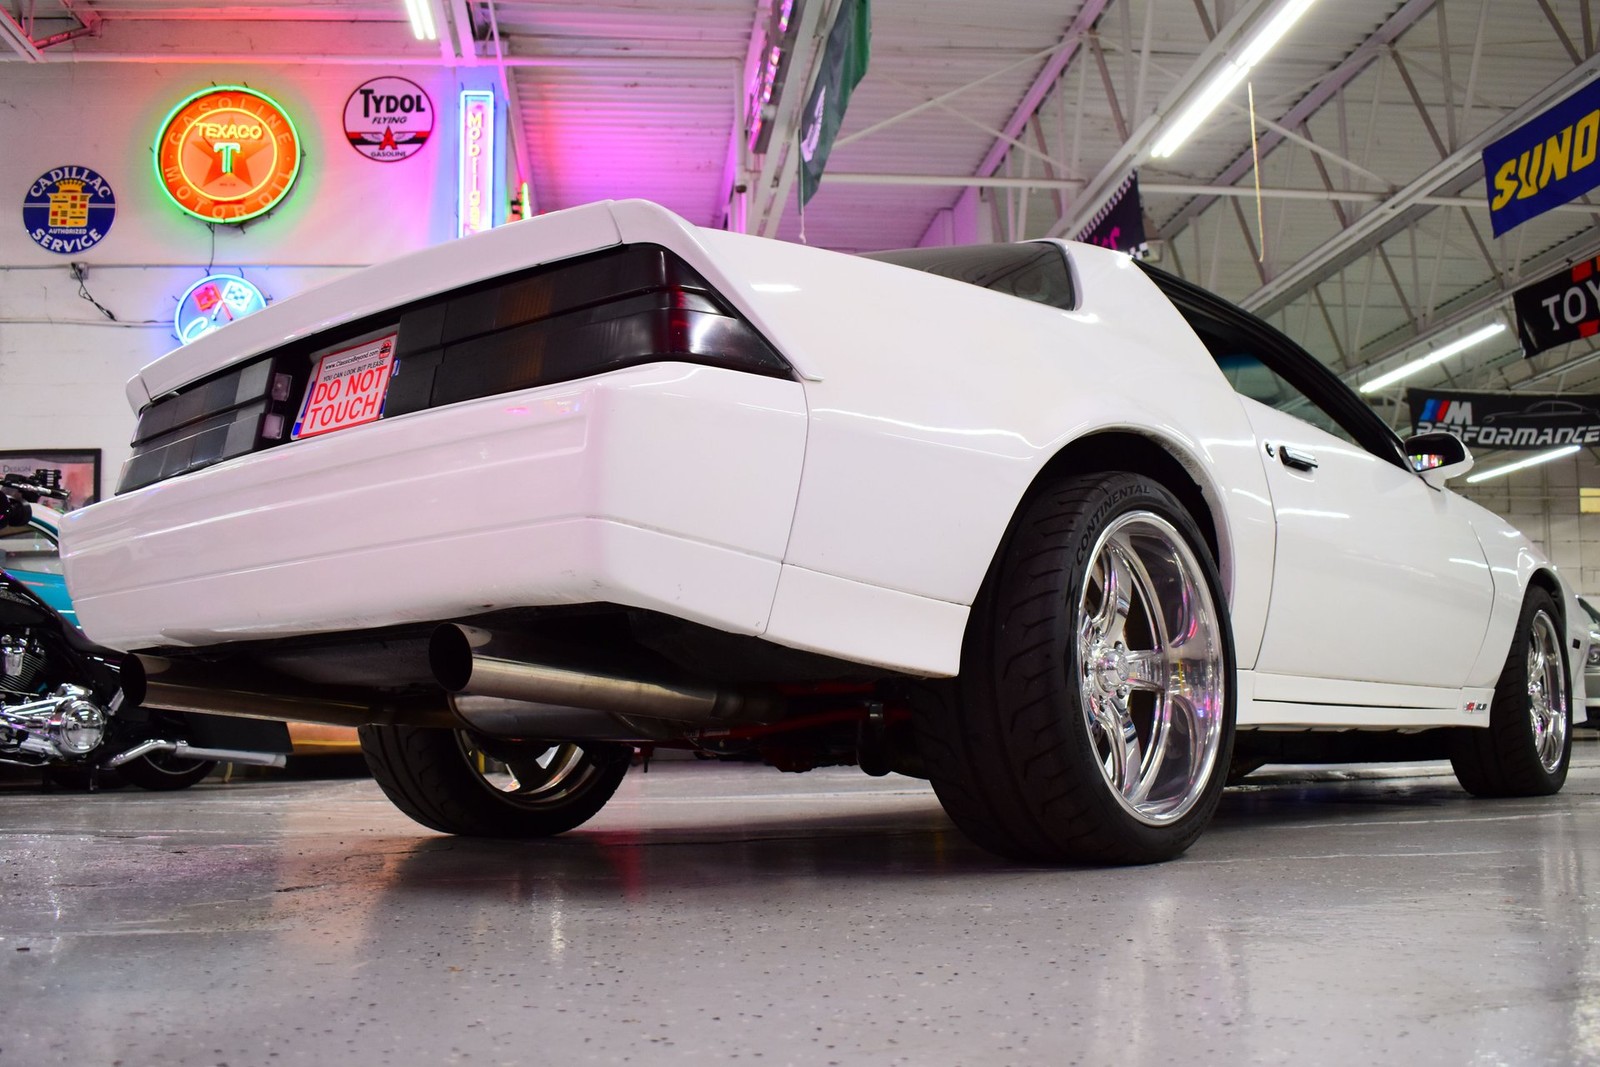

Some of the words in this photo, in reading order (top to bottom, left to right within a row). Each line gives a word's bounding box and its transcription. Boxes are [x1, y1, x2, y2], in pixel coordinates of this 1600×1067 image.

[359, 89, 425, 118] TYDOL
[170, 97, 291, 146] GASOLINE
[195, 122, 263, 140] TEXACO
[372, 116, 407, 124] FLYING
[213, 142, 241, 174] T
[1491, 109, 1600, 212] SUNO
[30, 167, 111, 198] CADILLAC
[165, 165, 247, 219] MOTOR
[257, 169, 294, 206] OIL
[32, 228, 102, 252] SERVICE
[314, 378, 341, 405] DO
[345, 365, 388, 397] NOT
[333, 371, 343, 380] CAN
[344, 368, 356, 377] LOOK
[357, 364, 367, 373] BUT
[367, 360, 385, 370] PLEASE
[309, 392, 379, 429] TOUCH
[1444, 401, 1473, 425] M
[1076, 484, 1150, 566] CONTINENTAL
